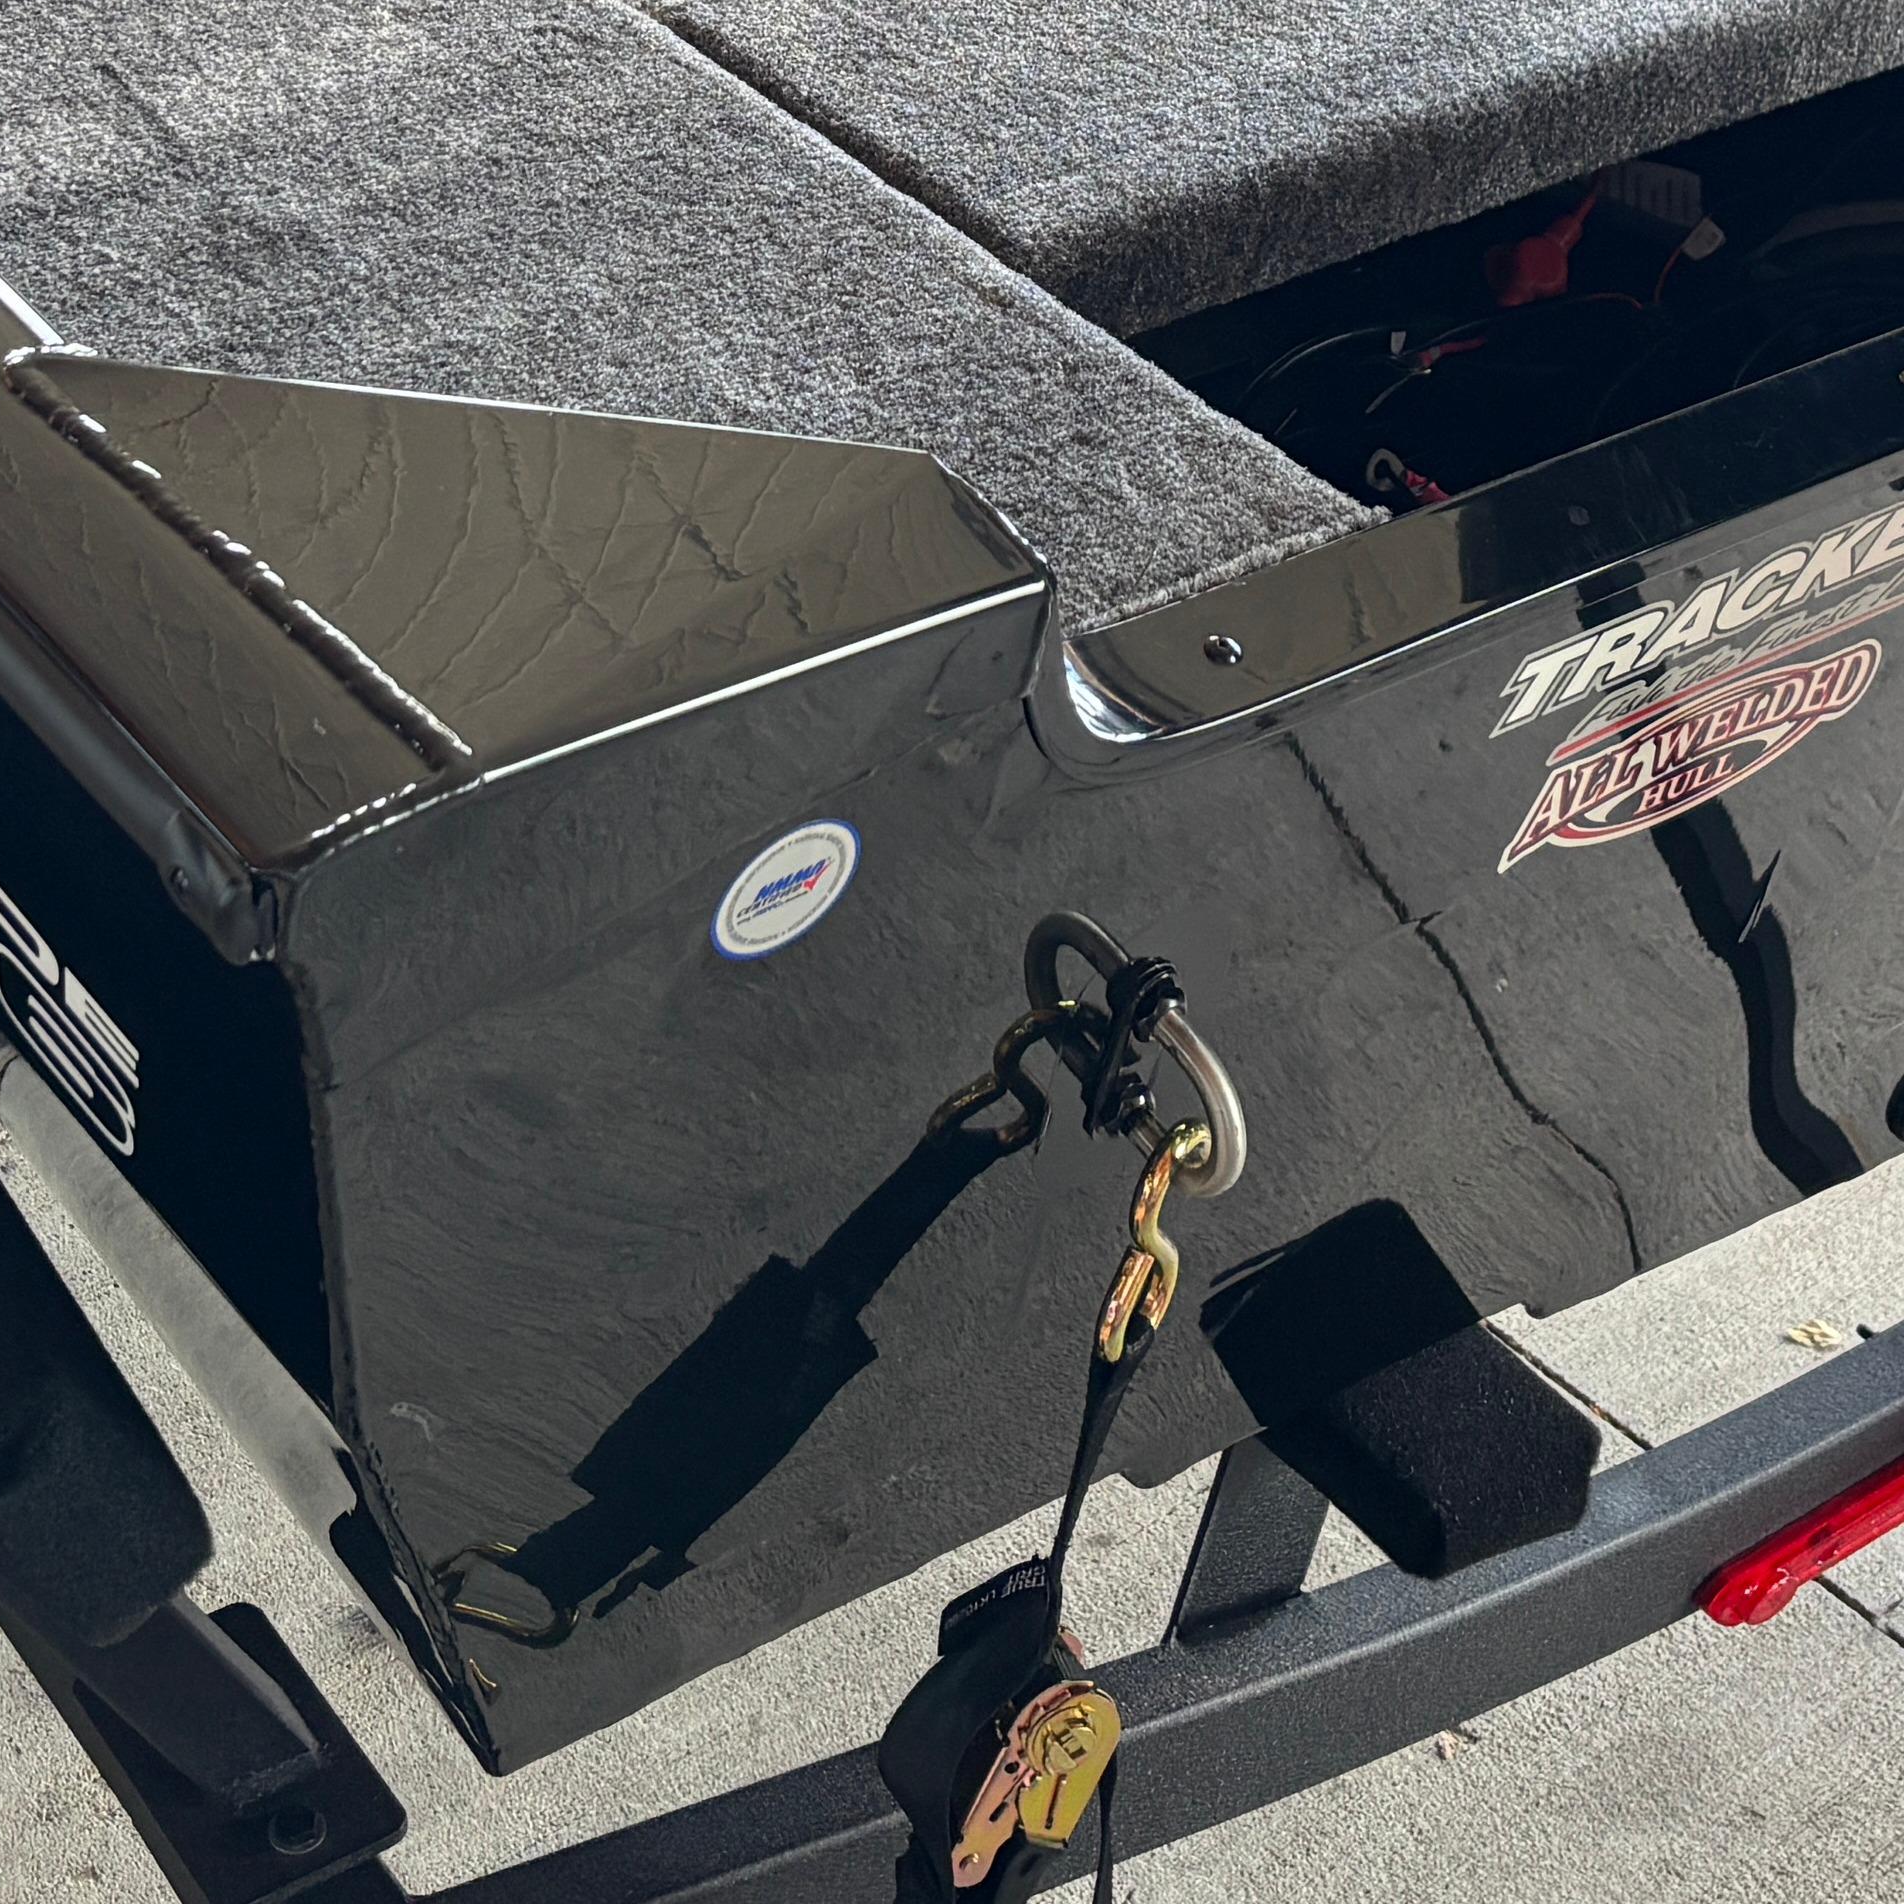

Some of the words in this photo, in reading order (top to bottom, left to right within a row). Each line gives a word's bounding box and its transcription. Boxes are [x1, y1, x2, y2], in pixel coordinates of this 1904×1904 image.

[1511, 741, 1645, 858] ALL
[1647, 646, 1874, 776] WELDED
[1633, 751, 1736, 818] HULL
